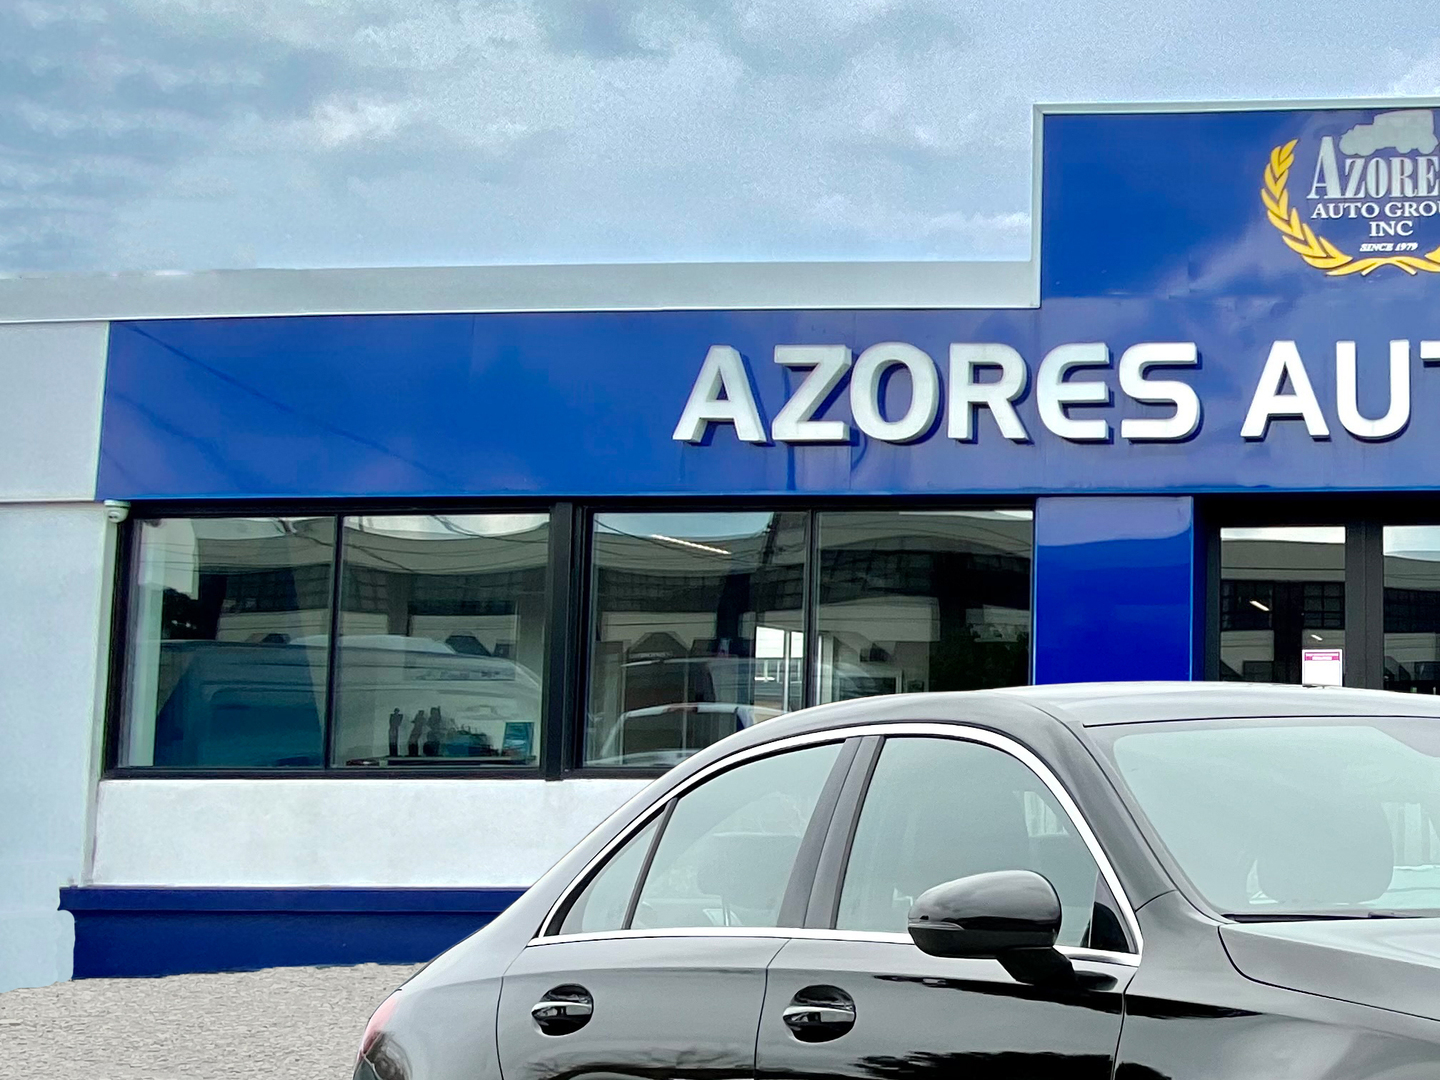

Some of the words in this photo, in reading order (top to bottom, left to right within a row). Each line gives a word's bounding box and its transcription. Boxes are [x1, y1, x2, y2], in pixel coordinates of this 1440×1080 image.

[1311, 202, 1380, 219] AUTO
[1369, 220, 1413, 237] INC
[1360, 242, 1394, 252] SINCE
[1394, 242, 1419, 251] 1979
[672, 341, 1202, 444] AZORES
